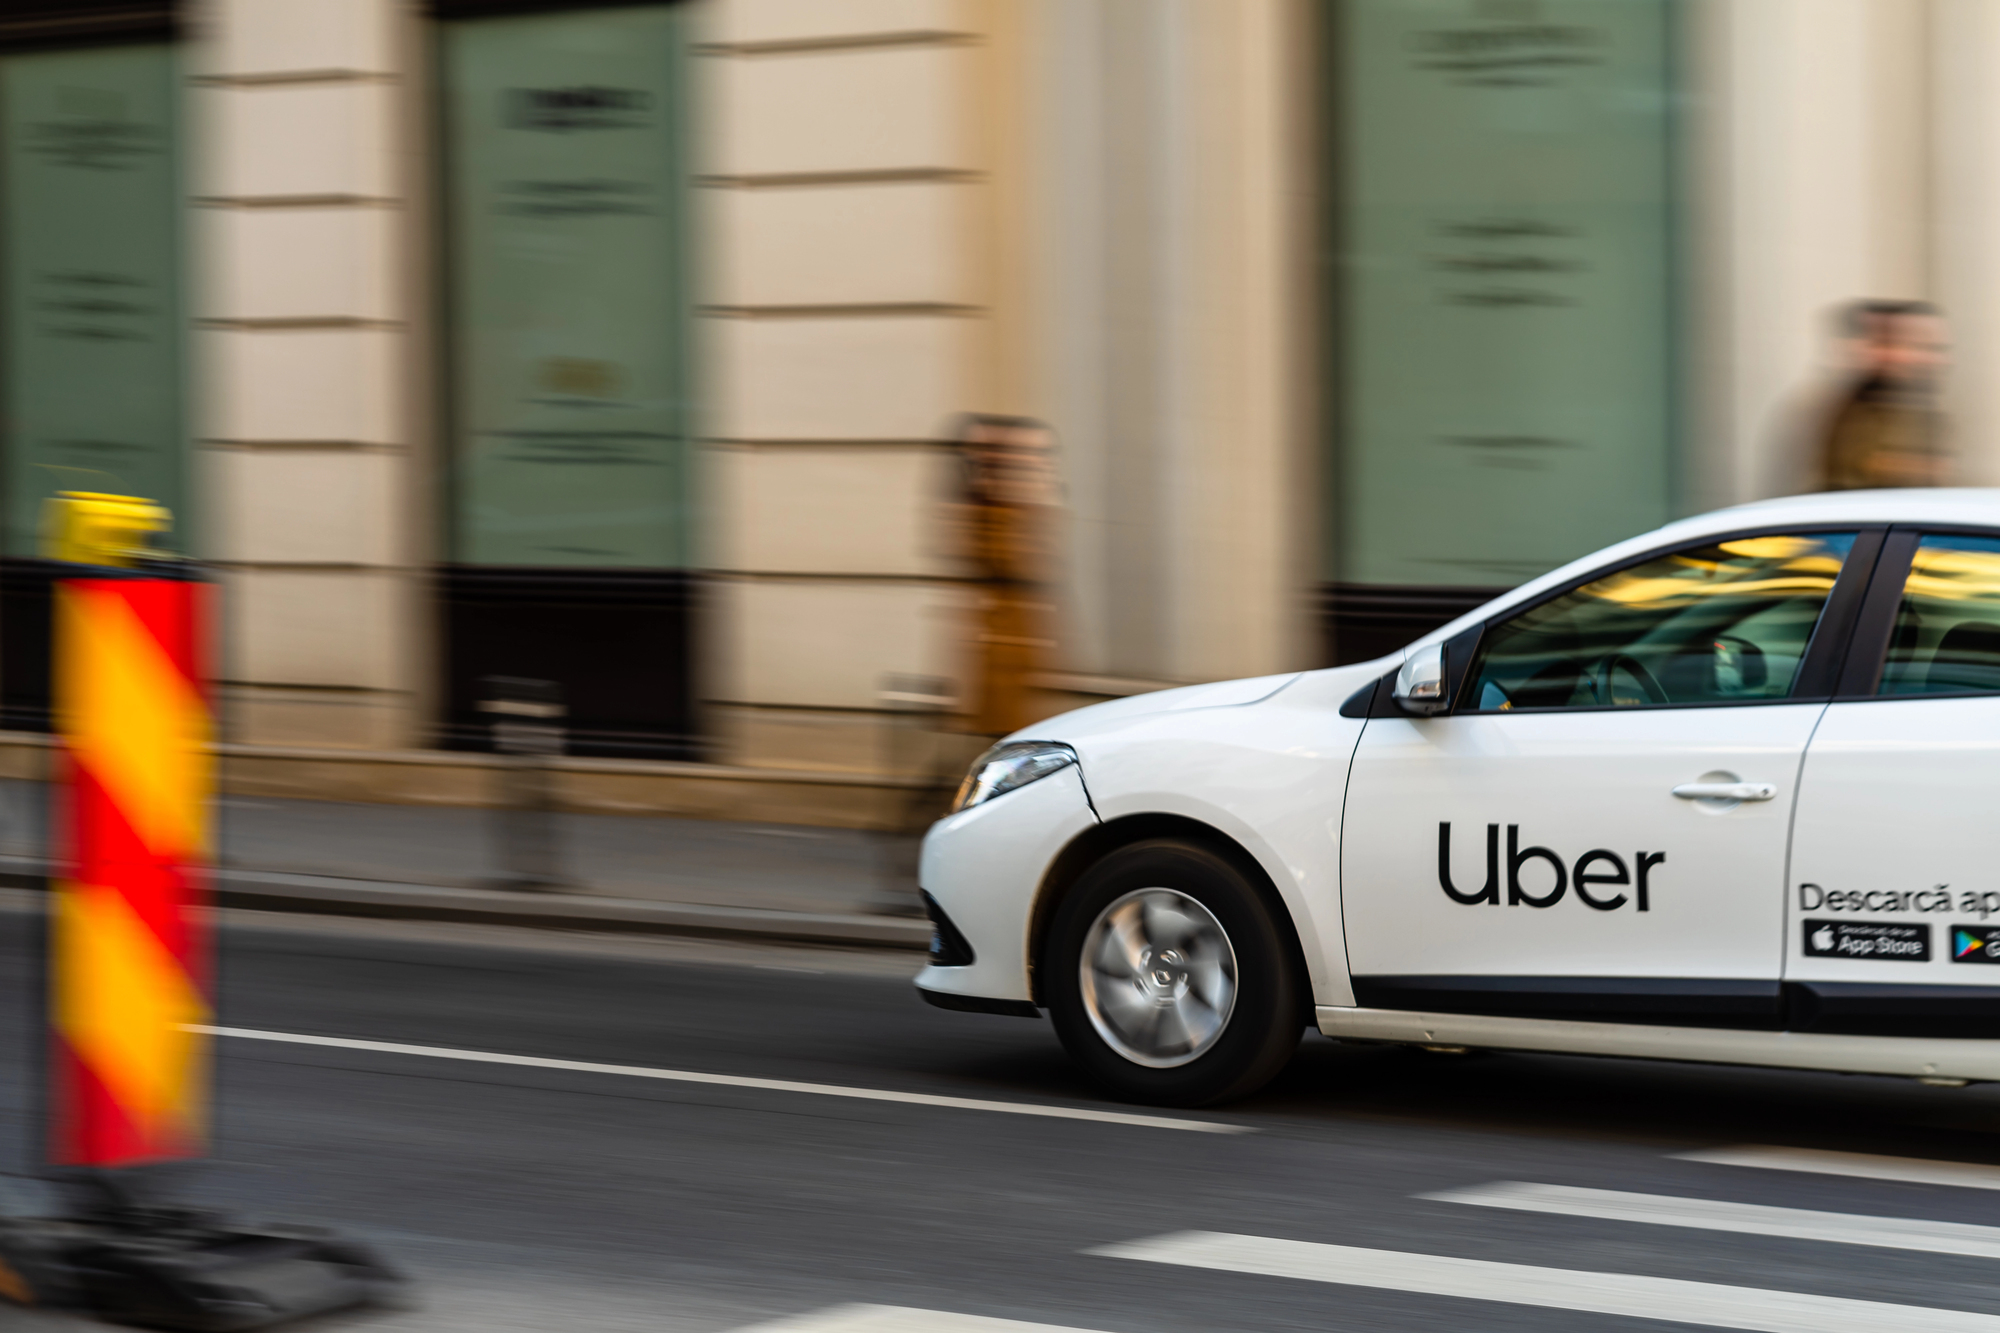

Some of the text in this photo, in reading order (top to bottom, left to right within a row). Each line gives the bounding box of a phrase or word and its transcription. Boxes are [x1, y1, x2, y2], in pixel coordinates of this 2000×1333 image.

[1438, 821, 1666, 912] Uber
[1799, 883, 1953, 912] Descarcă
[1837, 935, 1923, 956] App Store
